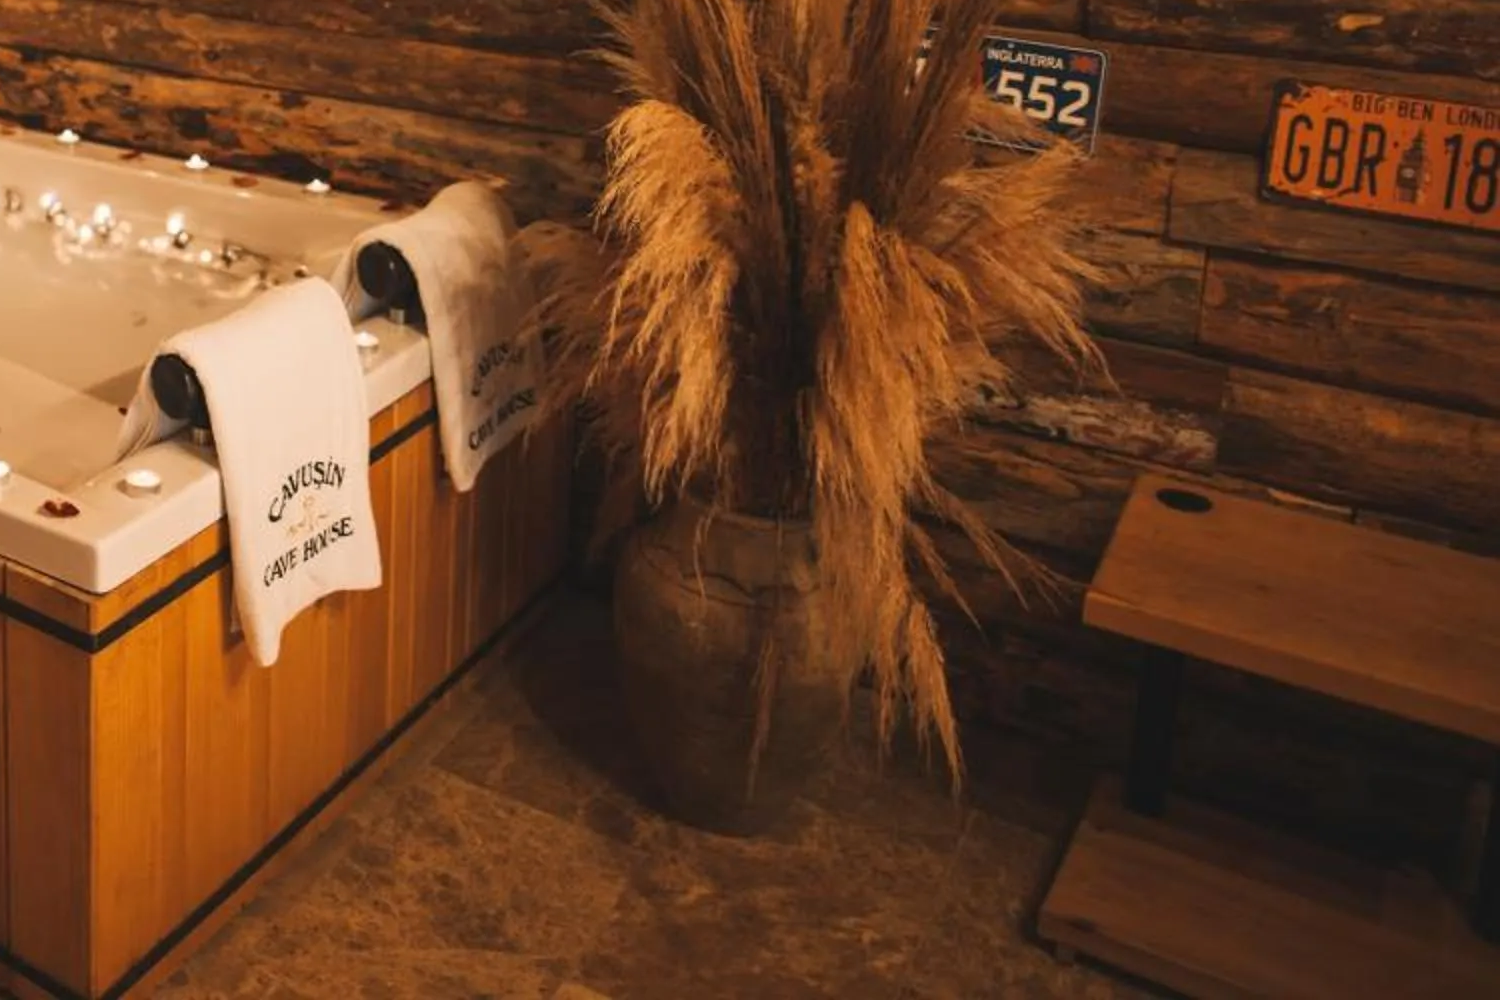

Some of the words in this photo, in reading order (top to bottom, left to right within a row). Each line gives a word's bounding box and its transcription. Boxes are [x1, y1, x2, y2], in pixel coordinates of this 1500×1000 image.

[986, 47, 1065, 71] INGLATERRA
[996, 69, 1091, 127] 552
[1352, 94, 1385, 114] BIG
[1397, 101, 1435, 122] BEN
[1446, 106, 1500, 130] LOND
[1282, 113, 1387, 197] GBR
[263, 548, 299, 588] CAVE
[302, 517, 354, 563] HOUSE
